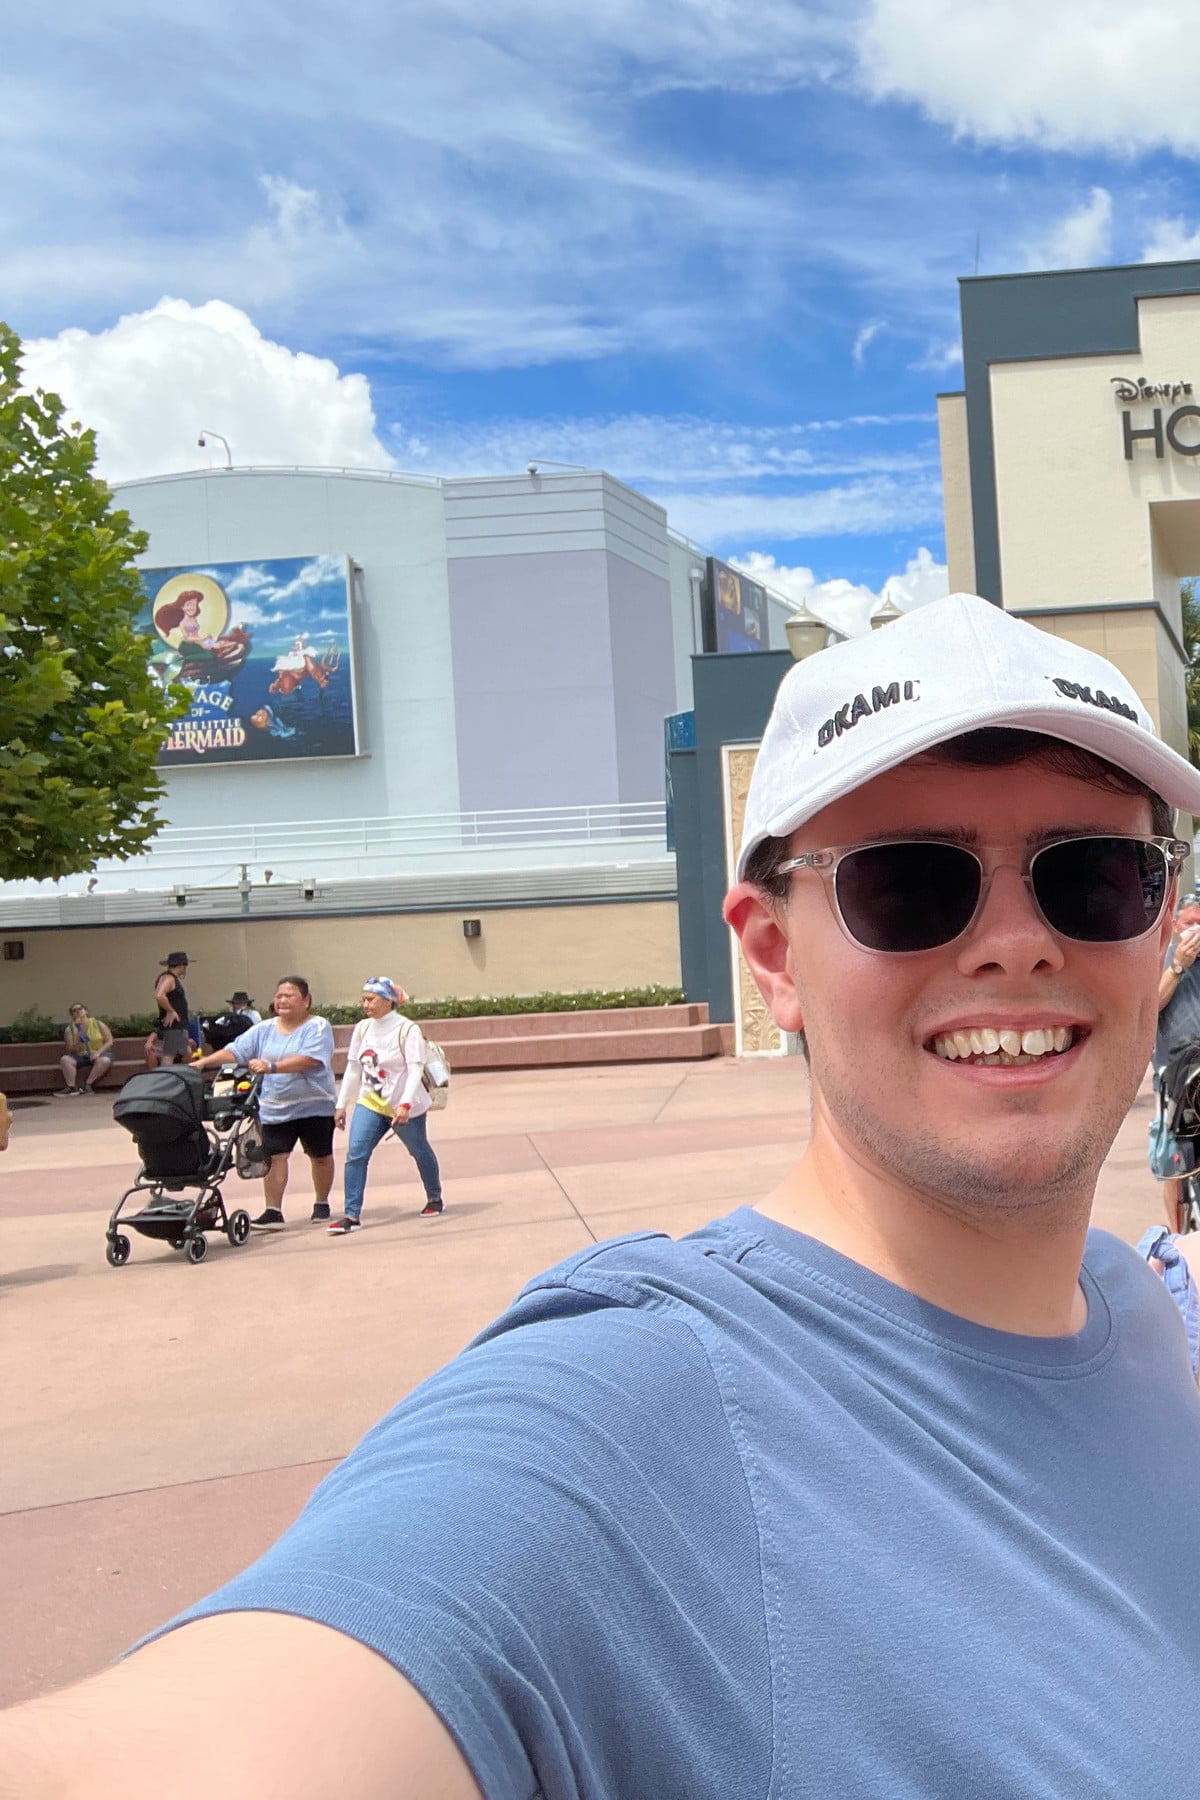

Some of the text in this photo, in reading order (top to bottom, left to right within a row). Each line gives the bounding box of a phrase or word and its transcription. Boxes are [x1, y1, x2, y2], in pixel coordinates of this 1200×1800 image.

[1110, 377, 1193, 405] Disney's
[177, 718, 242, 731] THE LITTLE
[817, 680, 914, 748] OKAMI
